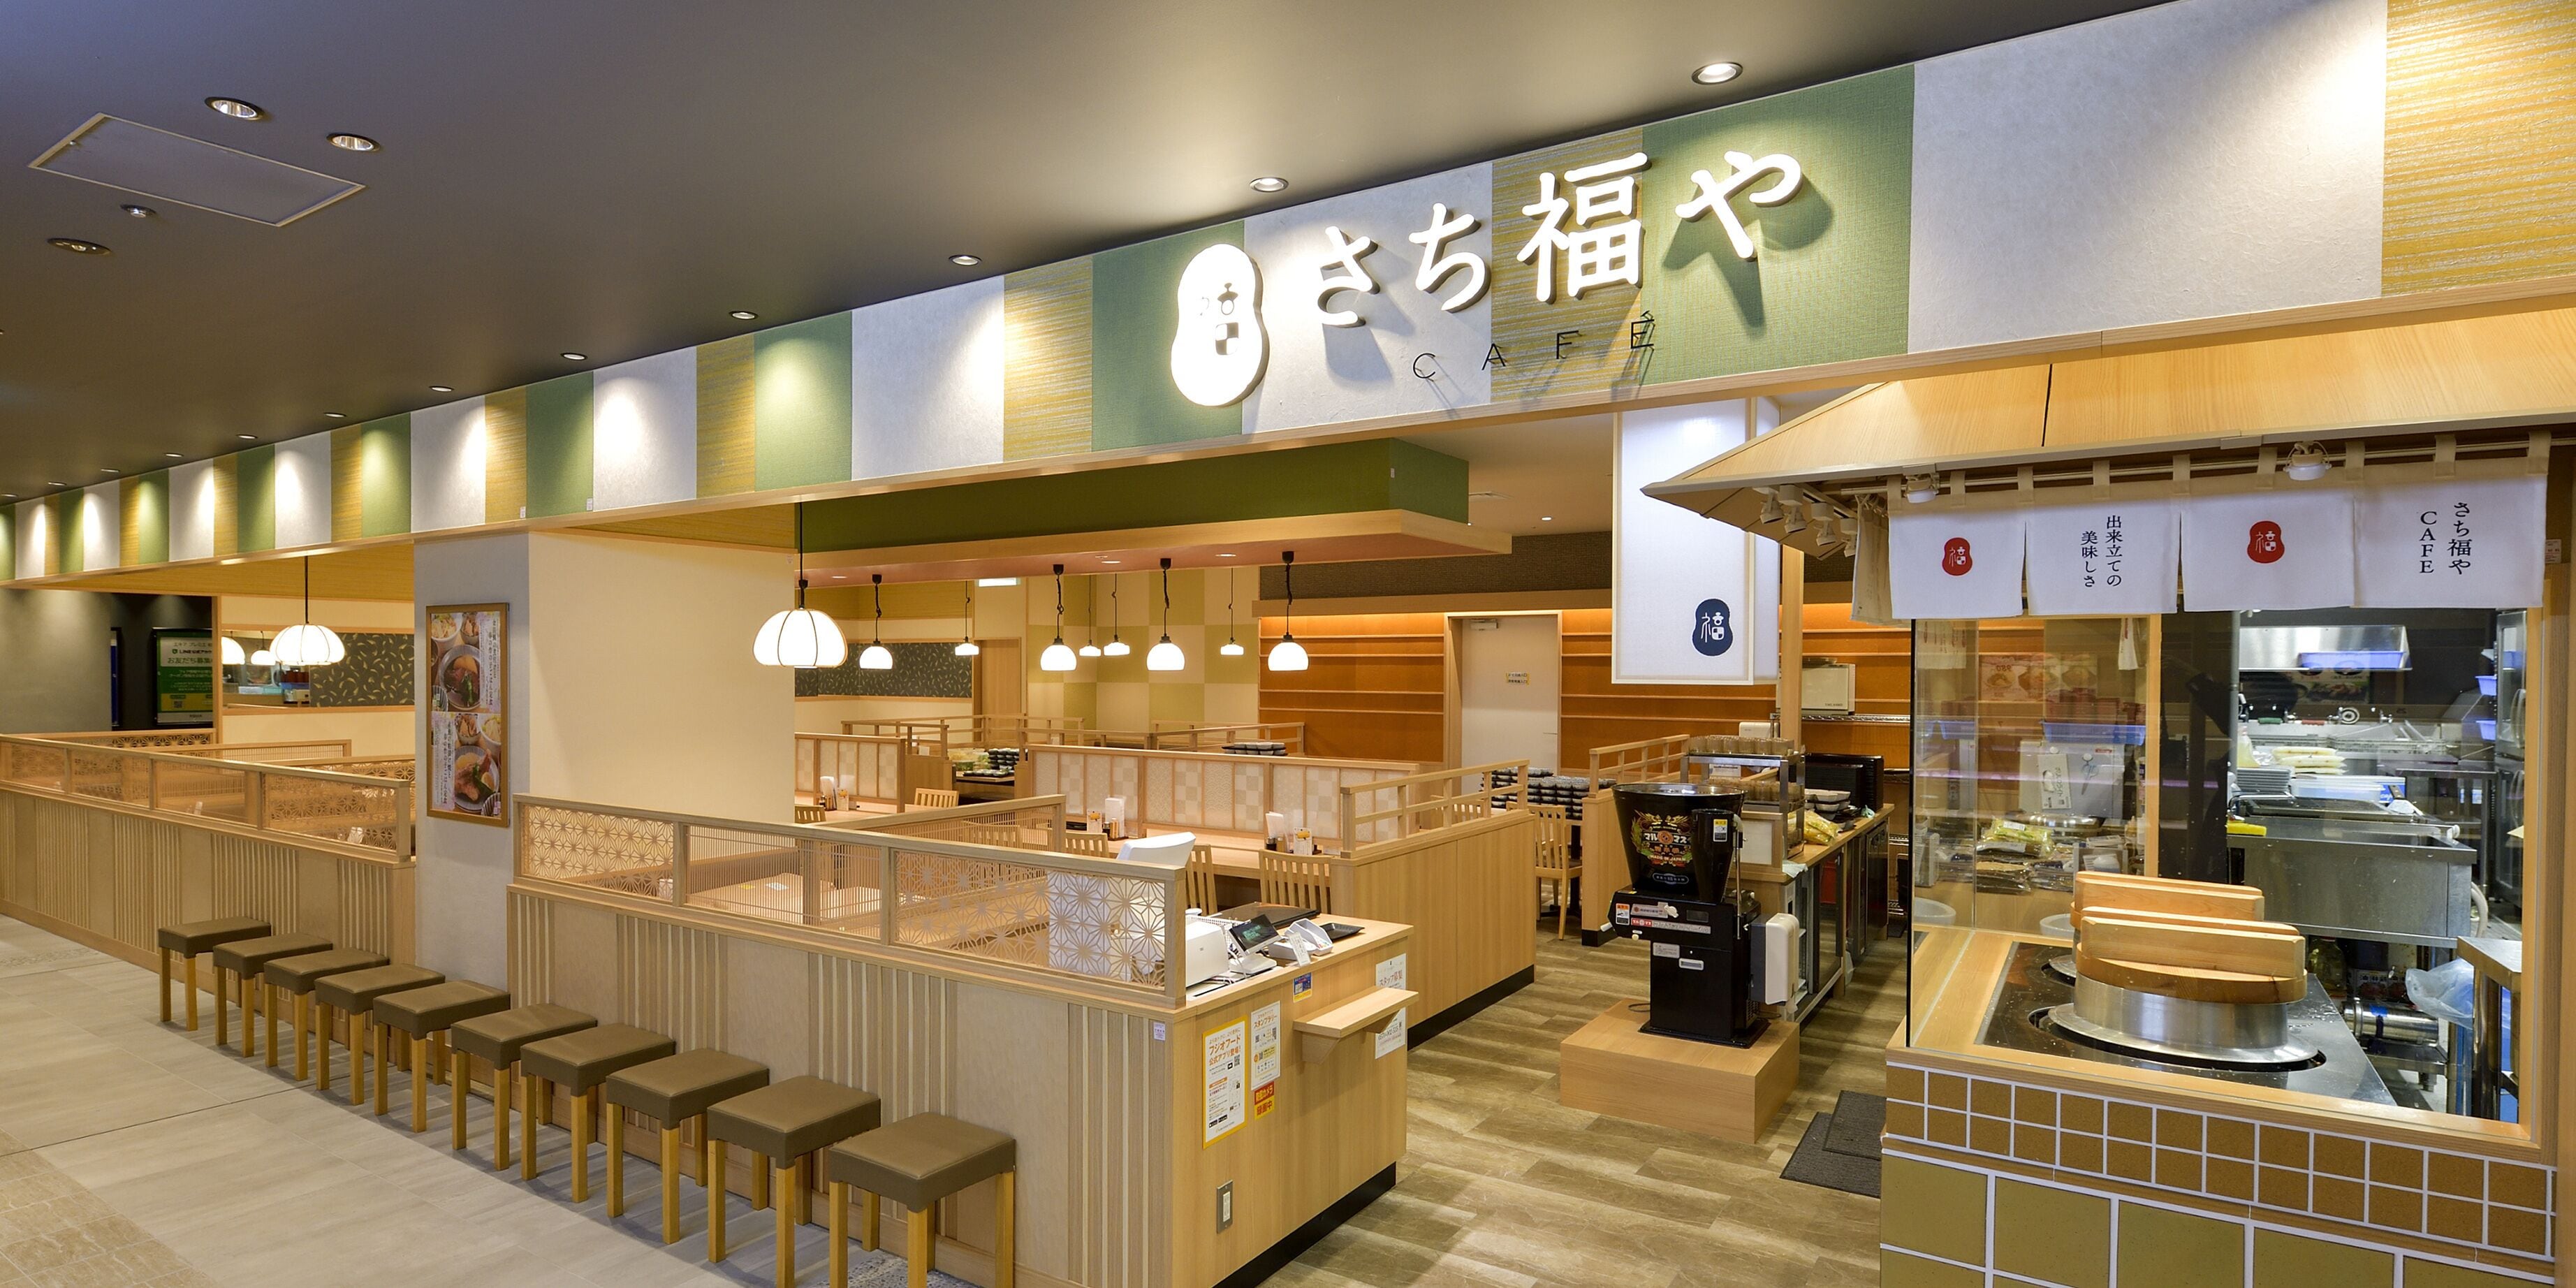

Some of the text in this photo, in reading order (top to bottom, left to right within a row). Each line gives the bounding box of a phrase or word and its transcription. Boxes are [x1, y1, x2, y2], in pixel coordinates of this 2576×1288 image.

[1317, 150, 1803, 327] さち福や
[1412, 309, 1655, 379] CAFÉ
[2081, 530, 2098, 587] 美味しさ
[2105, 515, 2123, 587] 出来立ての
[2419, 511, 2437, 573] CAFE
[2447, 502, 2473, 575] さち福や
[1209, 1034, 1241, 1055] フジオフード
